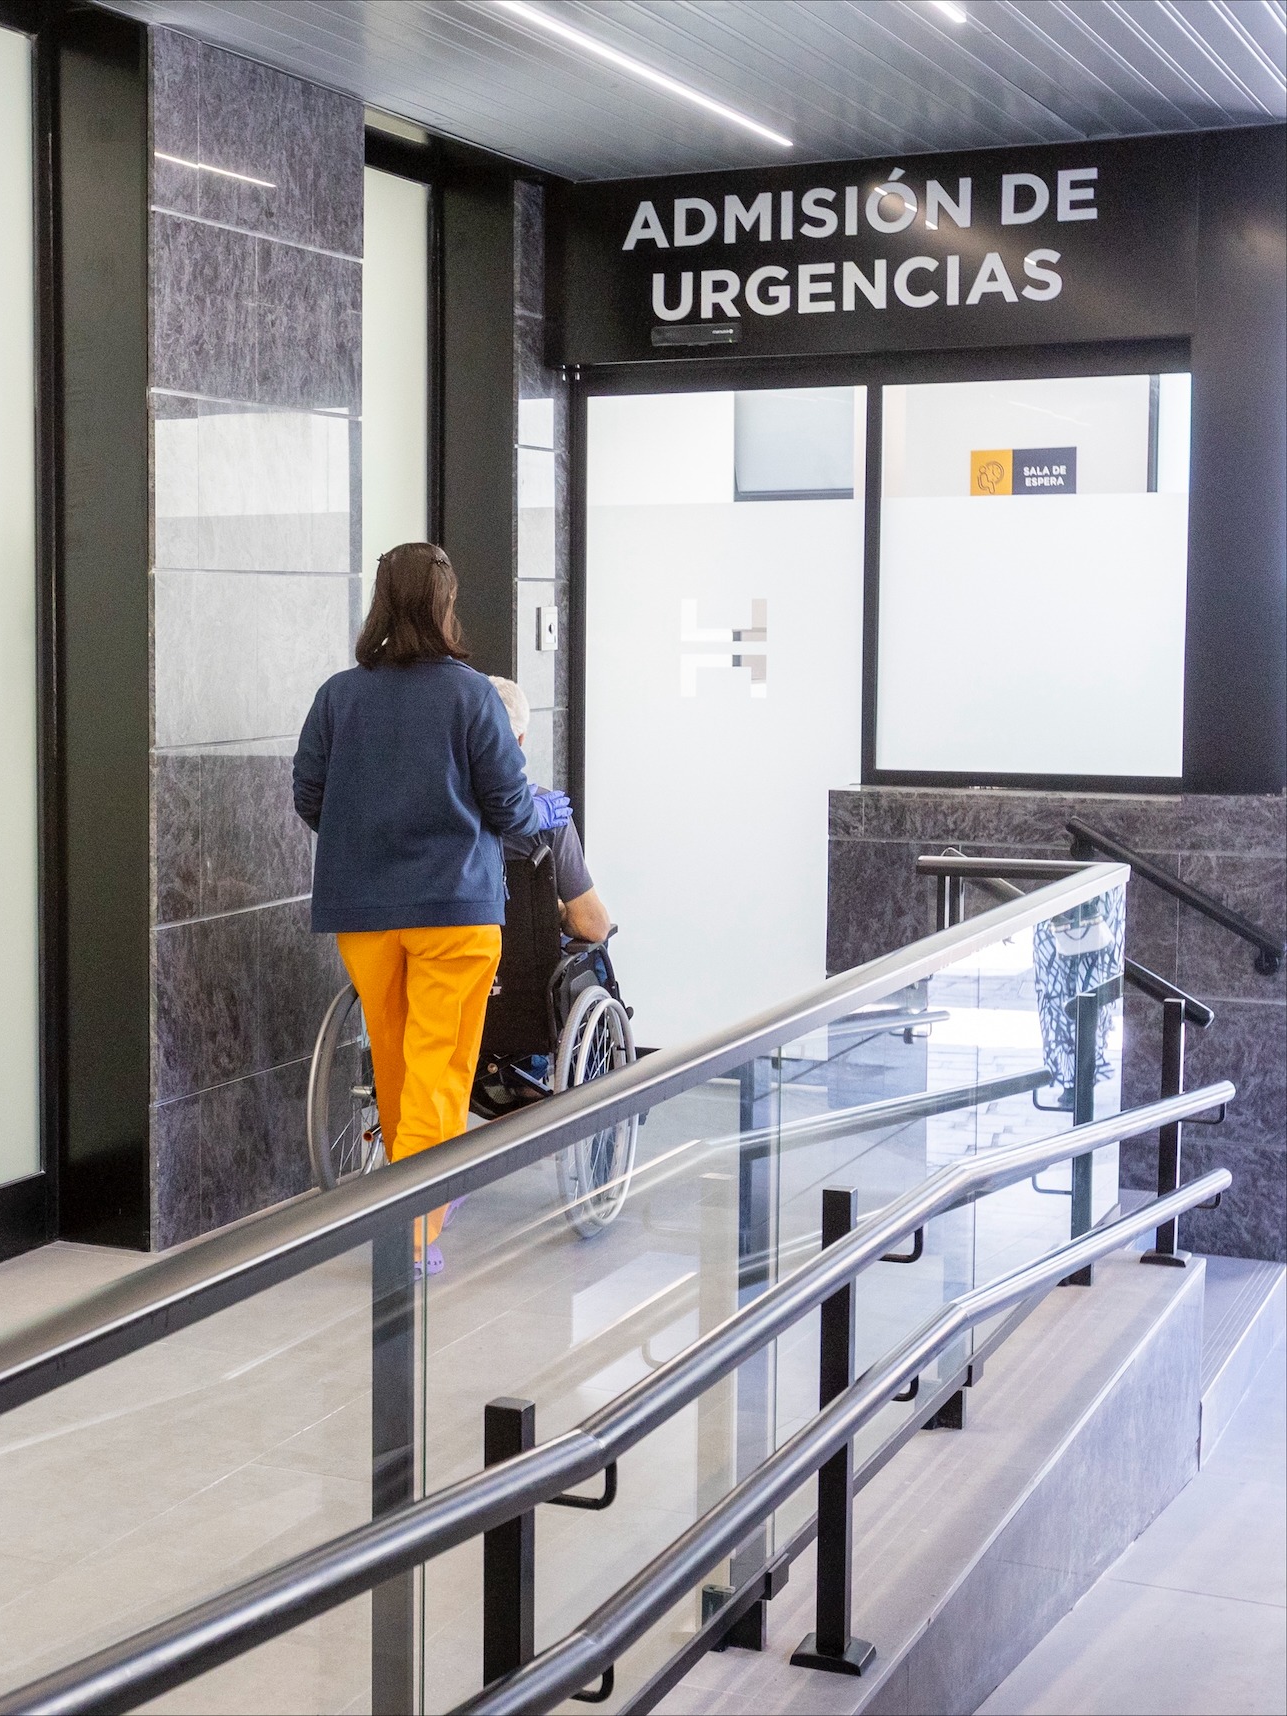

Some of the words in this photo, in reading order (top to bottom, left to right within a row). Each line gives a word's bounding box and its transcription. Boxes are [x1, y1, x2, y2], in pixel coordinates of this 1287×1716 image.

[622, 168, 973, 251] ADMISIÓN
[1001, 168, 1098, 226] DE
[652, 249, 1064, 322] URGENCIAS
[1023, 466, 1051, 476] SALA
[1052, 465, 1067, 475] DE
[1025, 476, 1065, 487] ESPERA
